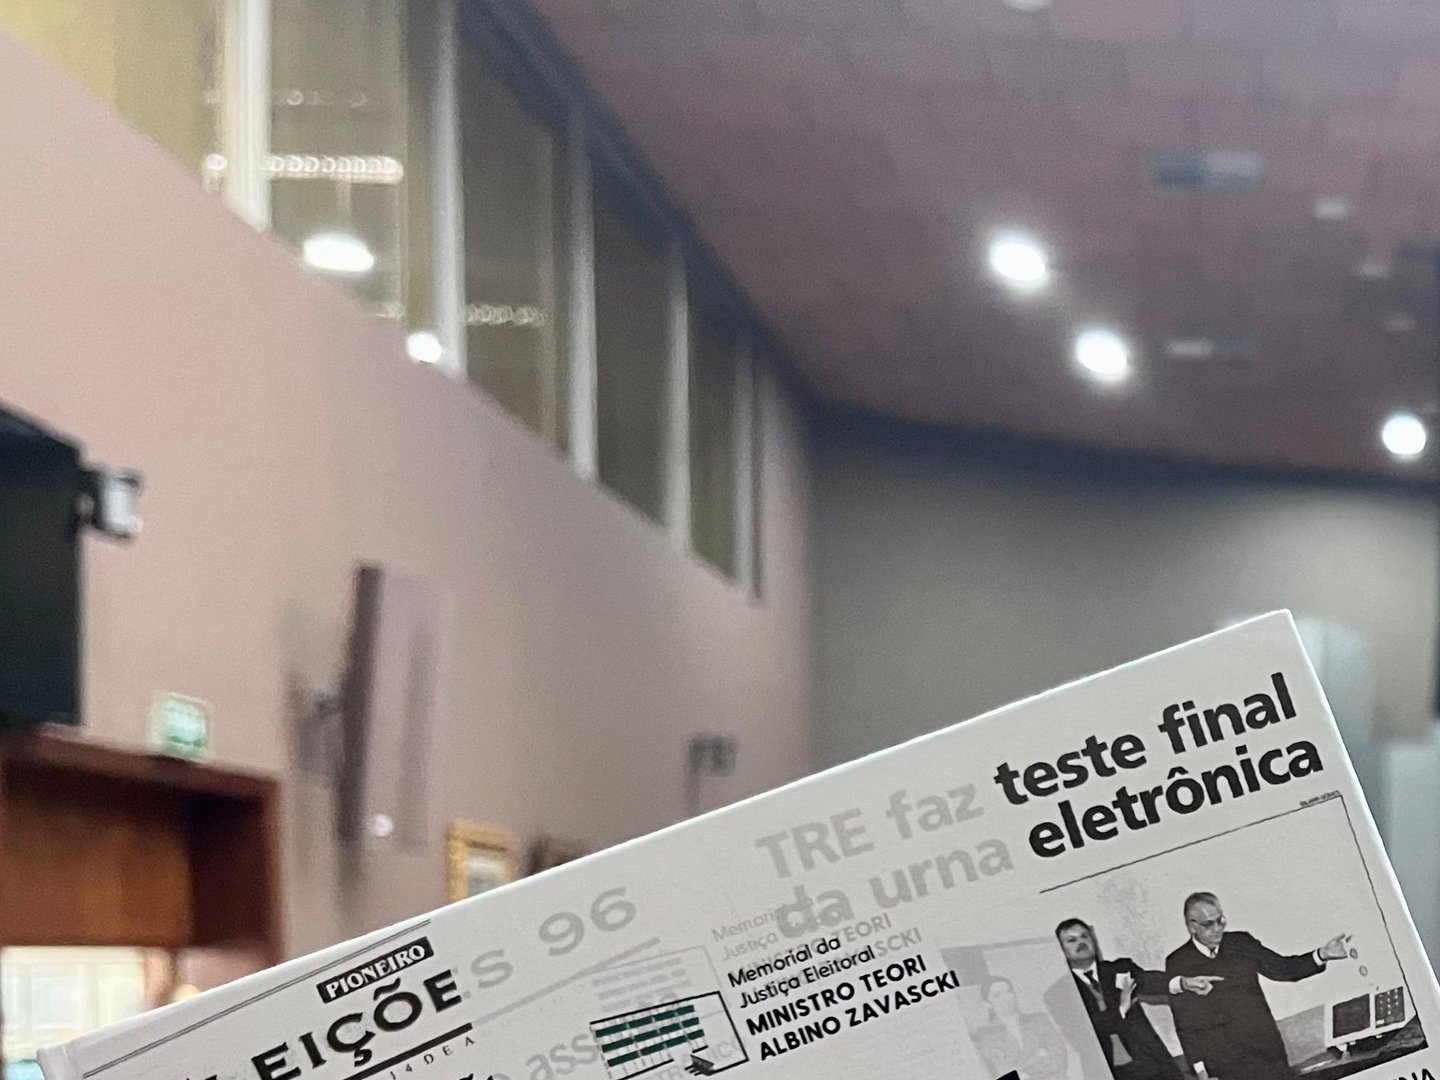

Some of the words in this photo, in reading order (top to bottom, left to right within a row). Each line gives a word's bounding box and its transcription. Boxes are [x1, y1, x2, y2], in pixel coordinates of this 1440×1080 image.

[754, 808, 875, 881] TRE
[886, 779, 985, 840] faz
[993, 734, 1147, 806] teste
[1157, 671, 1297, 755] final
[868, 840, 1013, 906] urna
[1028, 740, 1324, 858] eletrônica
[325, 942, 429, 1000] PIONEIRO
[727, 944, 813, 988] Memorial
[816, 937, 841, 955] da
[740, 976, 801, 1009] Justiça
[802, 944, 876, 984] Eleitoral
[745, 982, 855, 1036] MINISTRO
[858, 954, 927, 992] TEORI
[760, 1016, 841, 1061] ALBINO
[844, 970, 960, 1027] ZAVASCKI
